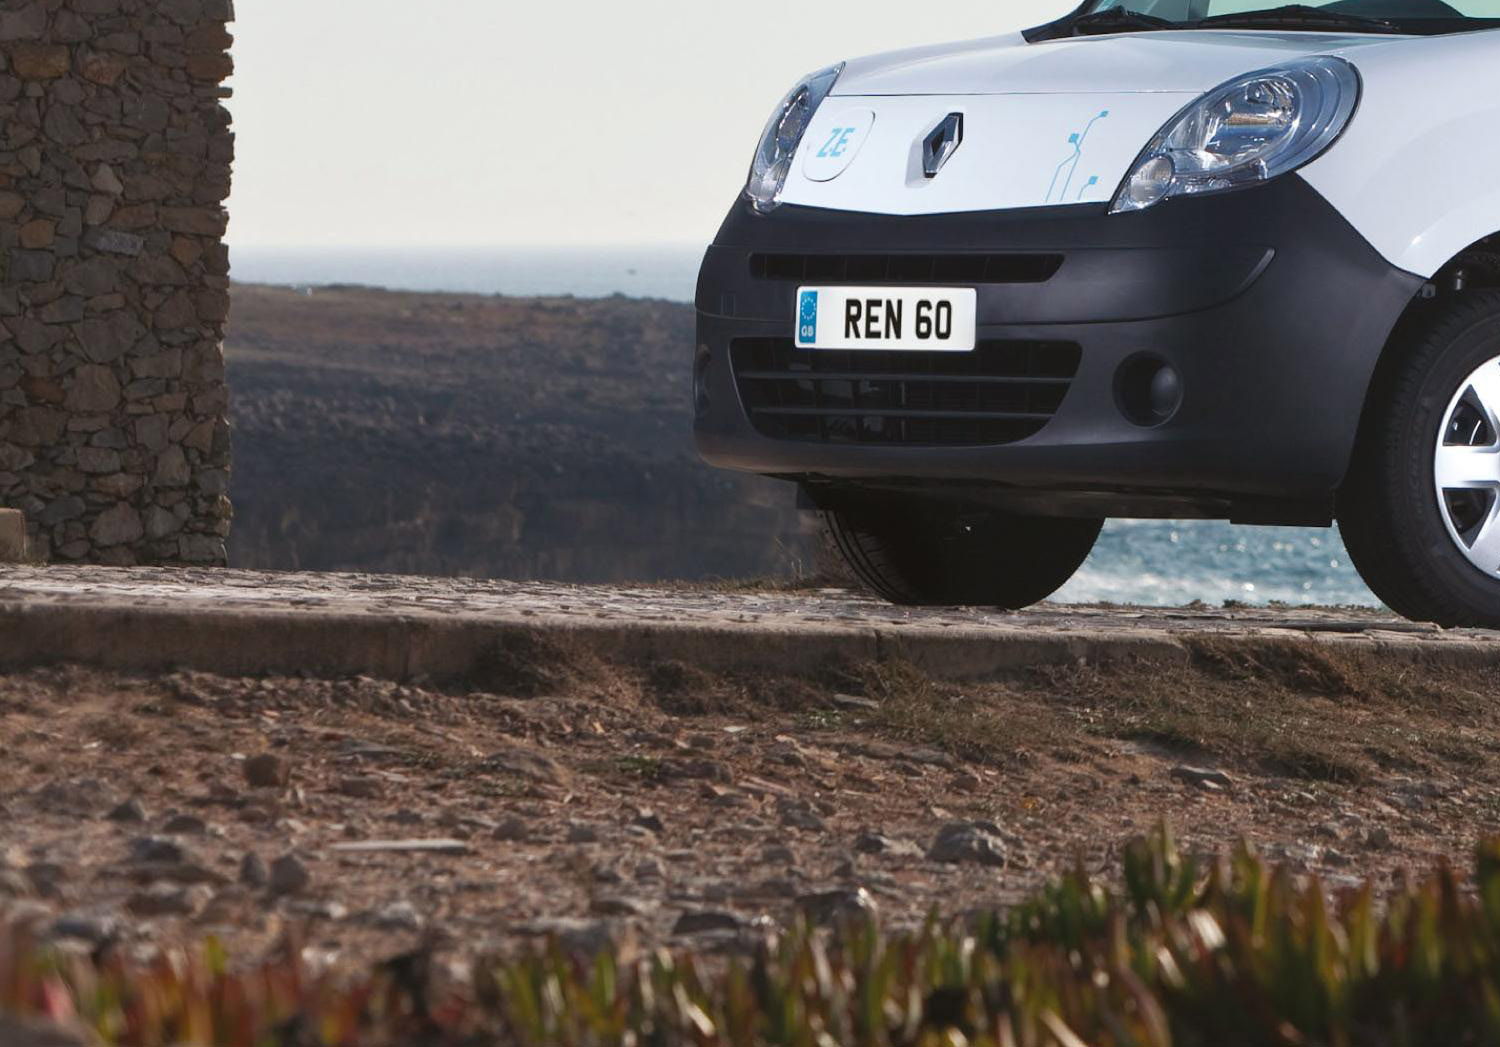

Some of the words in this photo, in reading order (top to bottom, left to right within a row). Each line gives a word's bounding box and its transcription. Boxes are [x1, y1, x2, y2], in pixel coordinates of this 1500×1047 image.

[801, 325, 814, 337] GB
[844, 298, 903, 340] REN
[915, 299, 952, 340] 60
